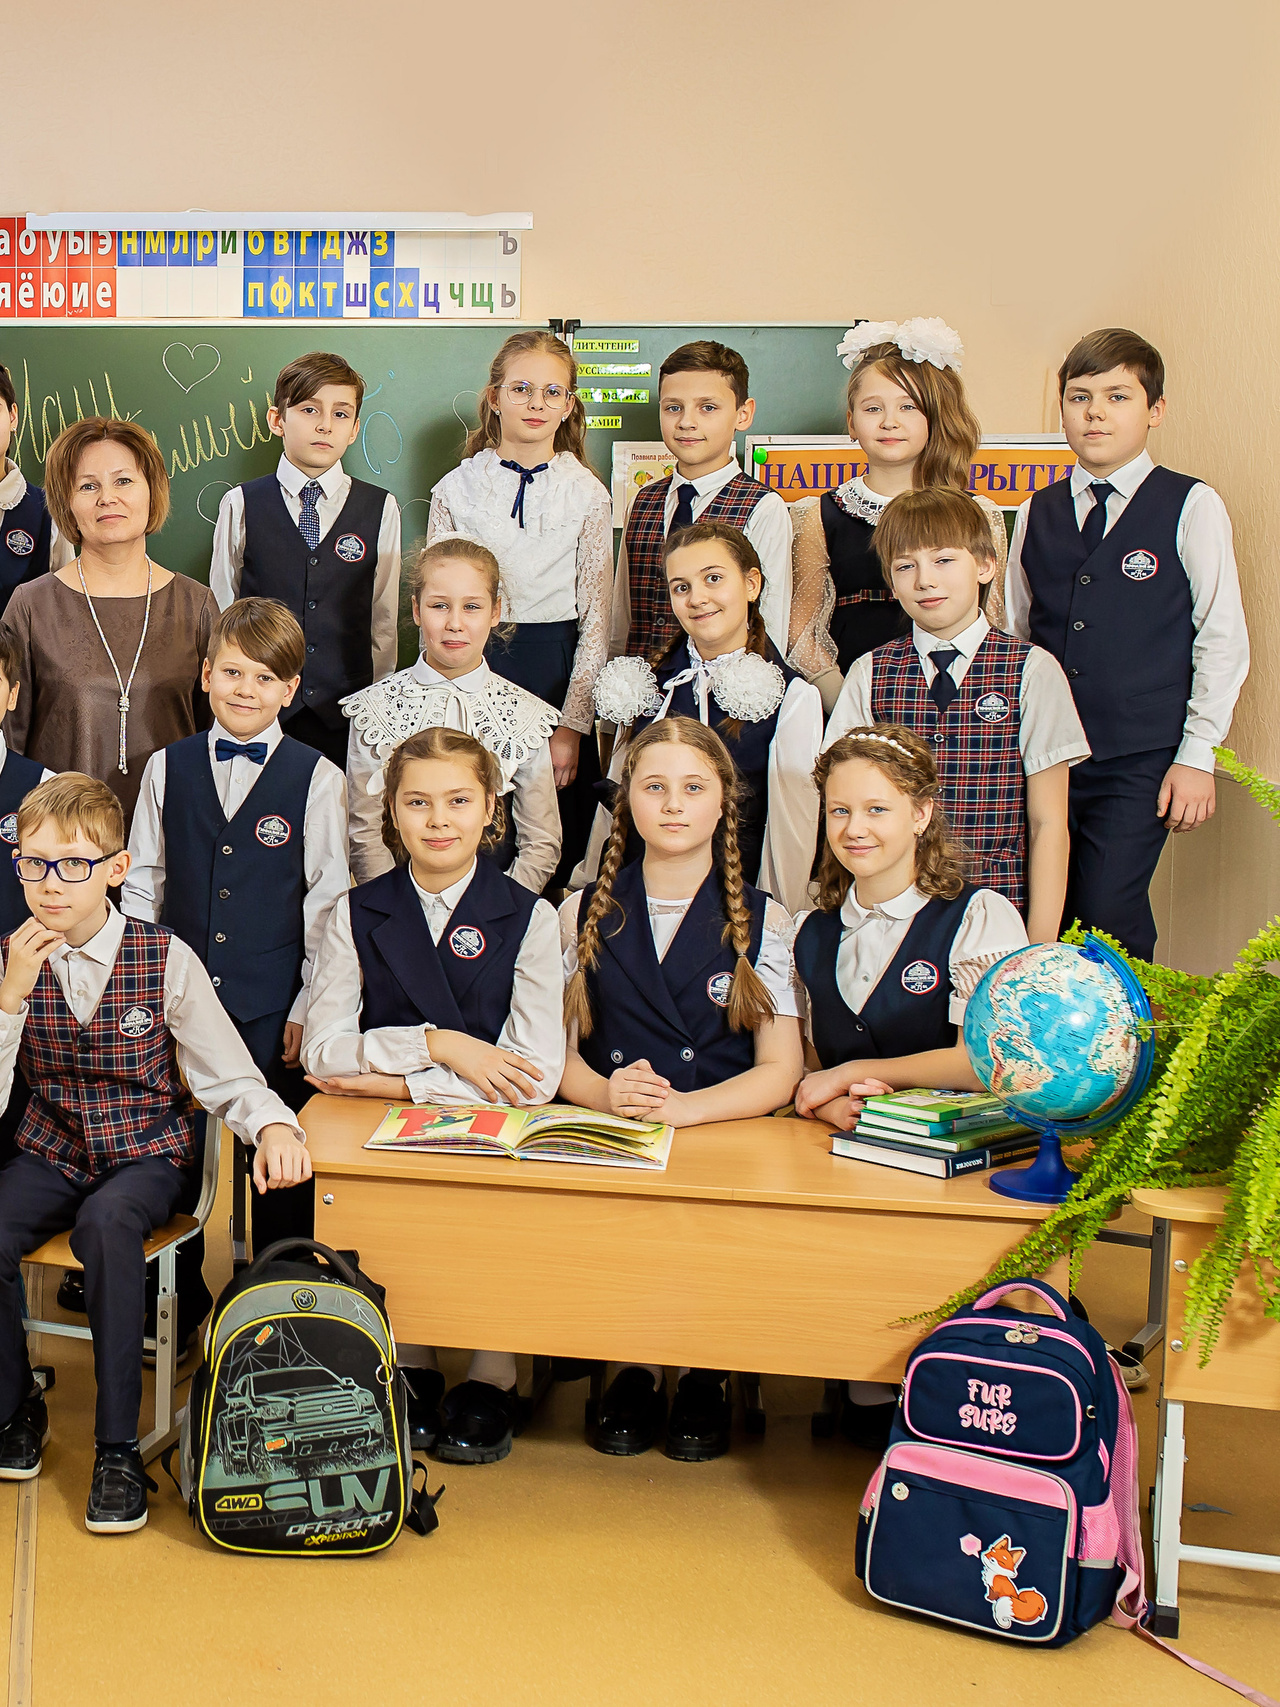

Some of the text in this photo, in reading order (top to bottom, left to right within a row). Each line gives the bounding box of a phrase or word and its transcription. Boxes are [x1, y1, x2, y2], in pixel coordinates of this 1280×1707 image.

[19, 230, 37, 255] о
[45, 231, 63, 263] у
[68, 231, 90, 255] ы
[97, 231, 113, 255] э
[121, 231, 137, 255] н
[144, 231, 166, 255] м
[172, 231, 188, 255] л
[196, 231, 214, 261] р
[274, 231, 290, 255] в
[300, 231, 312, 255] г
[322, 231, 341, 260] д
[346, 231, 368, 255] ж
[373, 231, 388, 255] з
[19, 272, 35, 309] ё
[42, 282, 65, 308] ю
[72, 282, 89, 308] и
[96, 282, 112, 309] е
[247, 282, 264, 307] п
[270, 276, 292, 314] ф
[299, 282, 315, 307] к
[322, 282, 337, 307] т
[346, 283, 367, 307] ш
[374, 282, 389, 307] с
[398, 283, 415, 307] х
[424, 283, 440, 313] ц
[450, 283, 463, 307] ч
[472, 283, 493, 313] щ
[501, 283, 516, 307] ь
[966, 463, 1075, 491] РЫТИ
[967, 1378, 1012, 1410] FUR
[958, 1403, 1017, 1436] SURE
[217, 1467, 391, 1518] 4WD SUV
